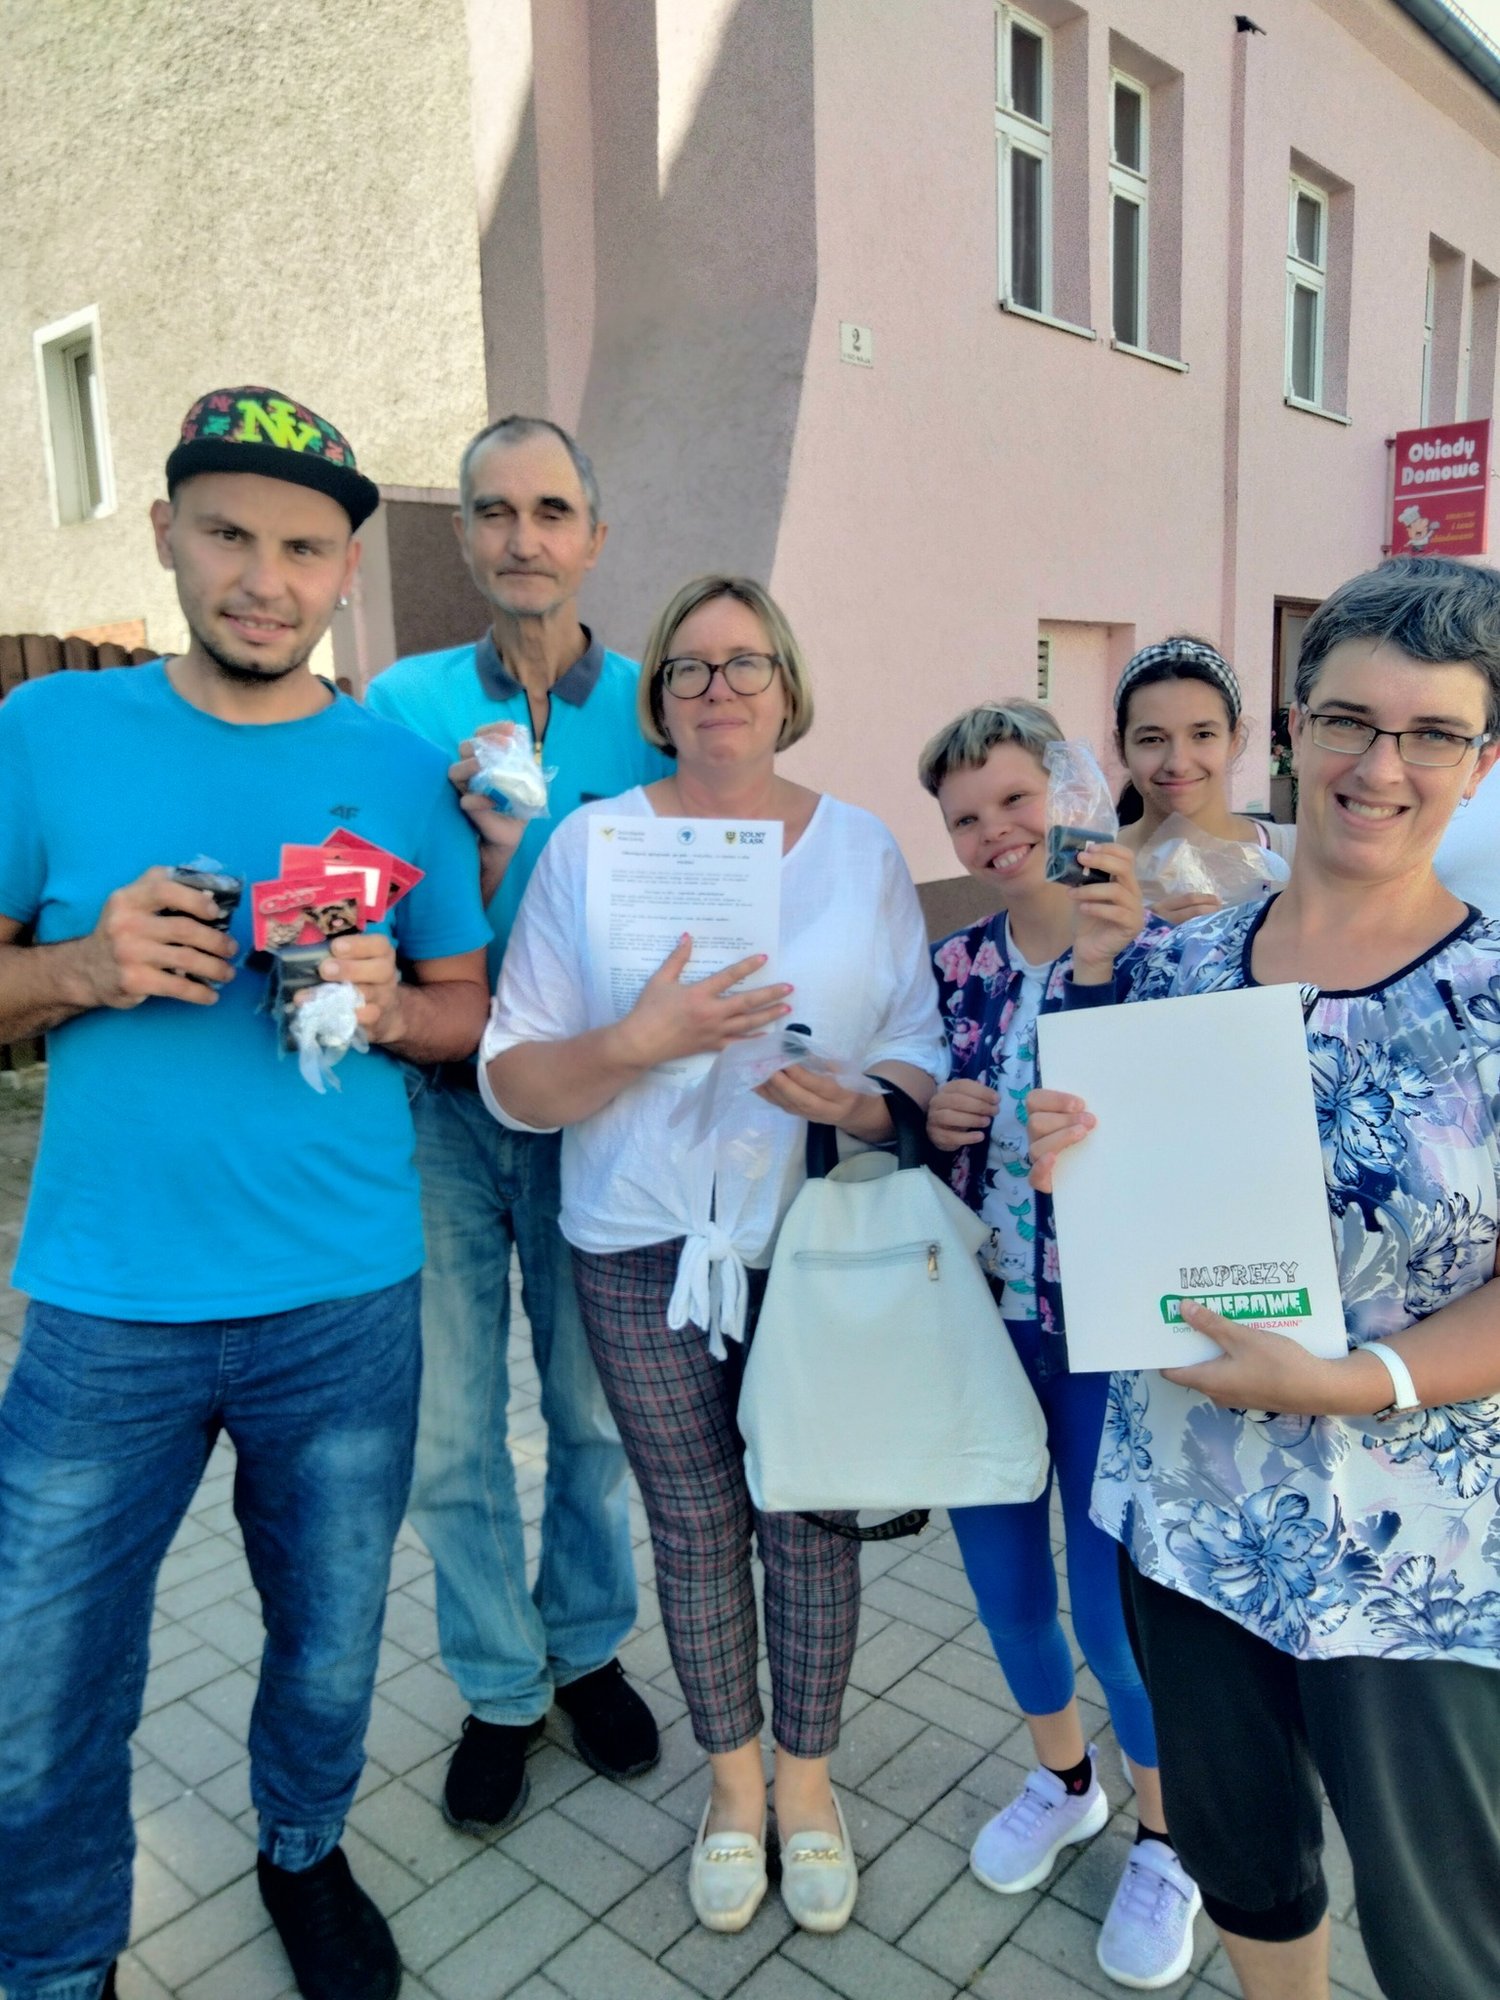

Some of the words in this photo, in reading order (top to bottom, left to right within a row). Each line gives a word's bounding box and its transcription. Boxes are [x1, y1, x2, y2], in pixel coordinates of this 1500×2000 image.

[851, 328, 861, 352] 2
[1408, 436, 1476, 463] Obiady
[1401, 461, 1480, 486] Domowe
[1179, 1261, 1299, 1289] IMPREZY
[1172, 1326, 1192, 1334] Dom
